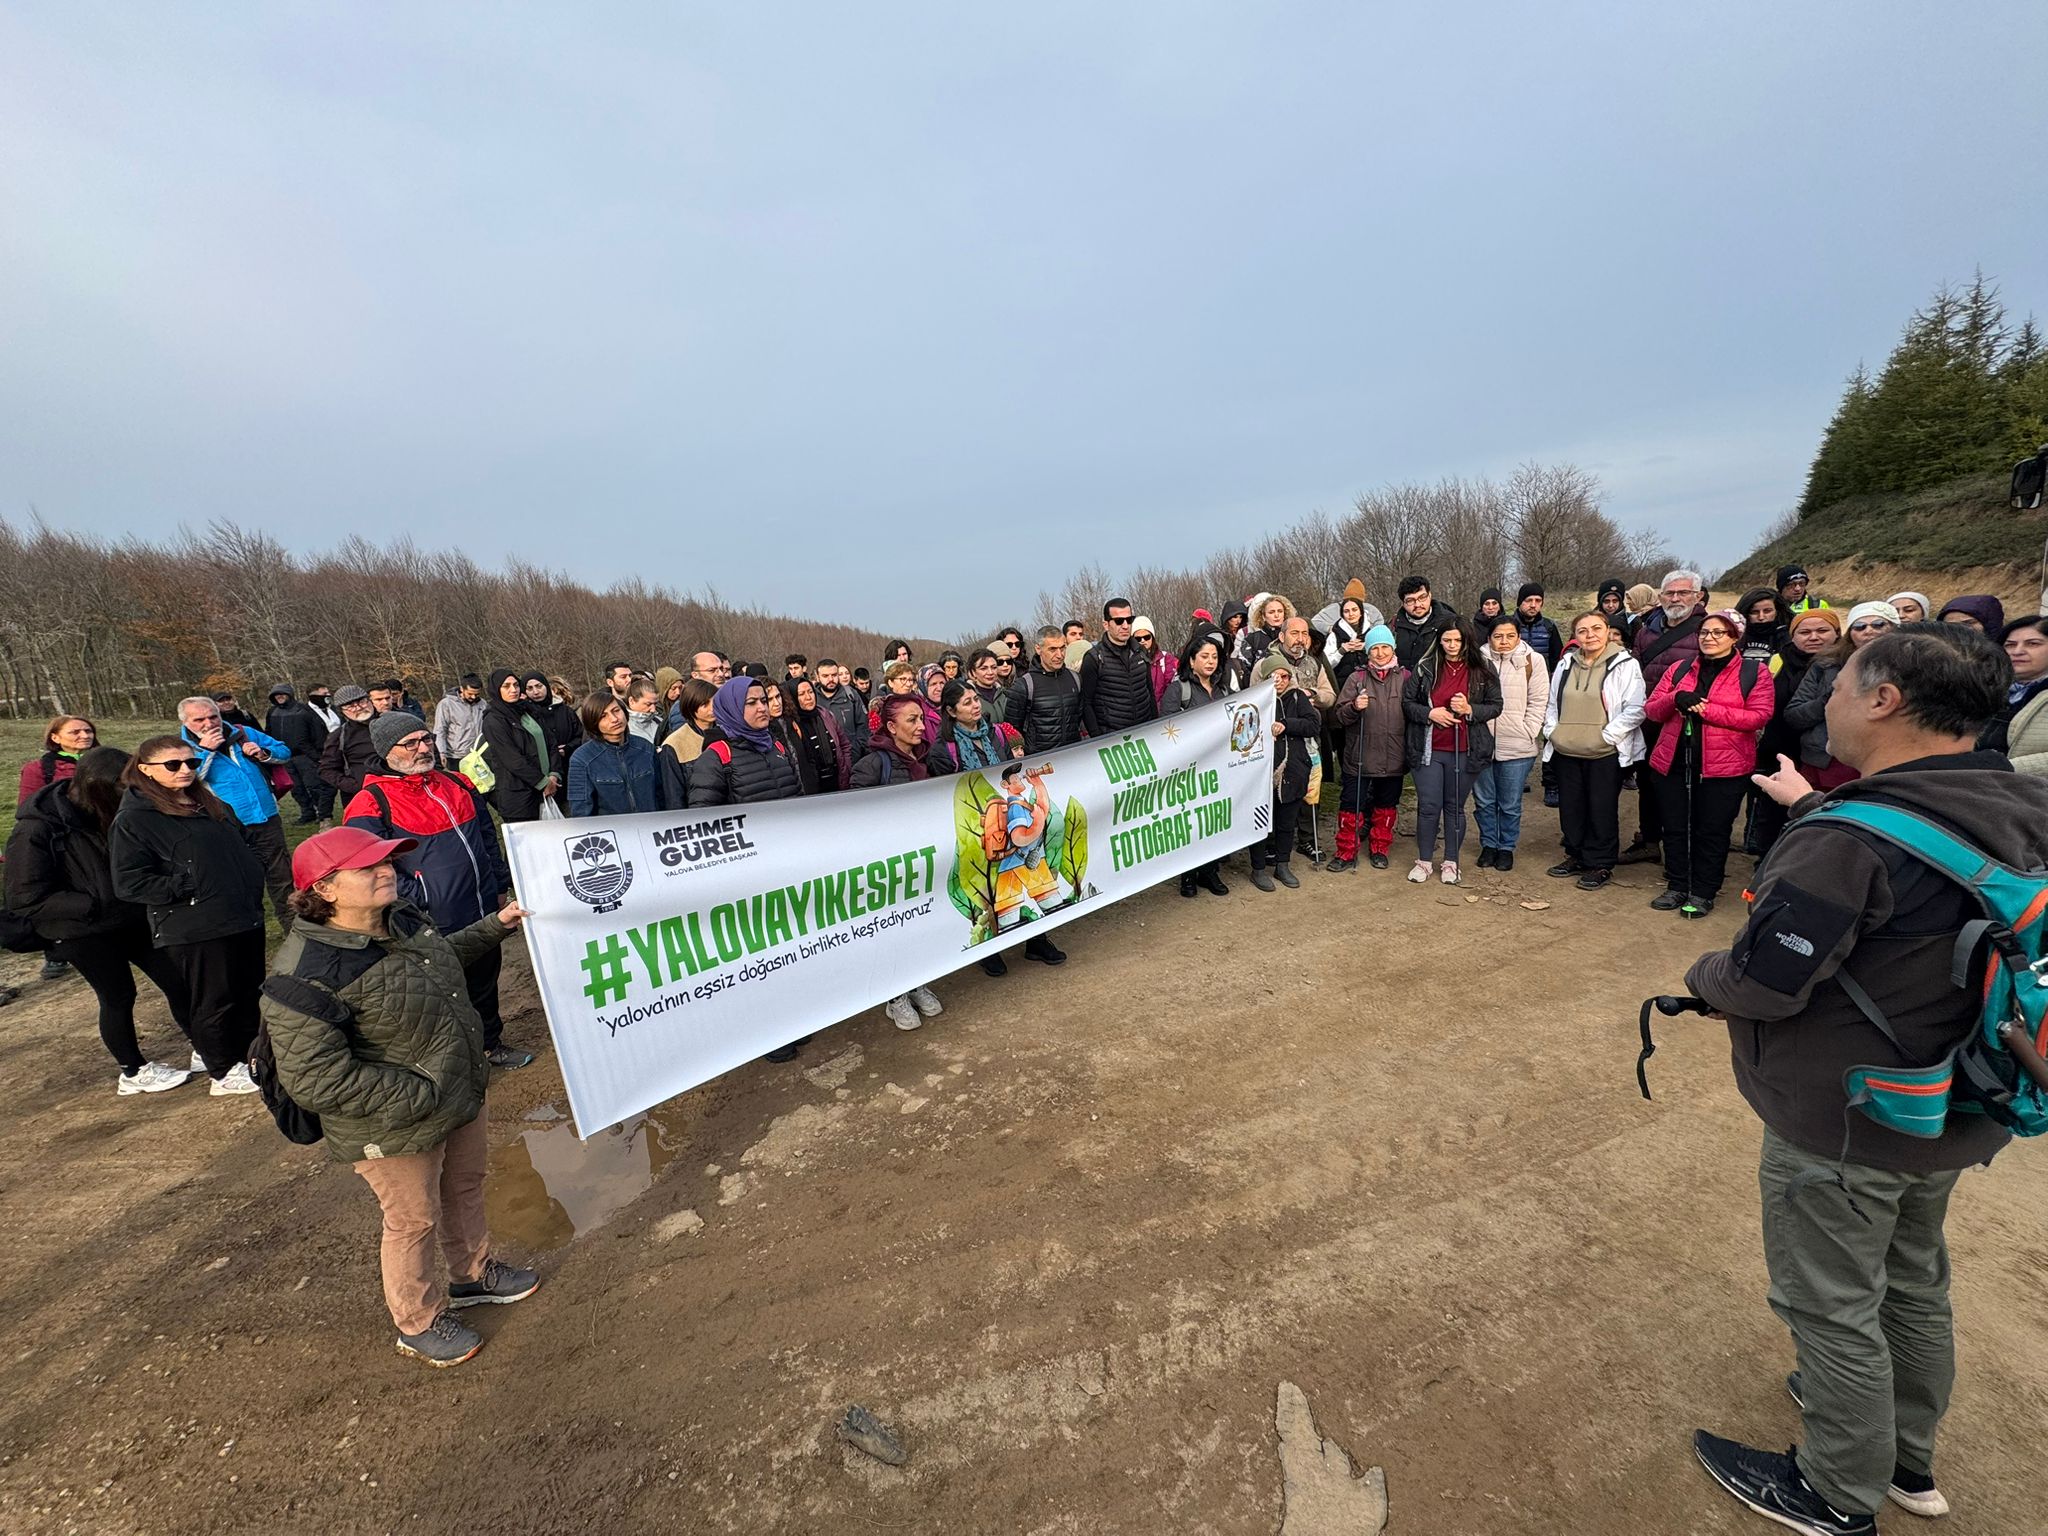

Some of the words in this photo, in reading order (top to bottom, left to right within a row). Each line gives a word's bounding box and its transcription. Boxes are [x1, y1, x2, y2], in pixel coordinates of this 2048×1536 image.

[1098, 735, 1157, 785] DOĞA
[1113, 761, 1197, 826] YÜRÜYÜŞÜ
[1199, 769, 1219, 798] ve
[652, 814, 746, 847] MEHMET
[659, 832, 754, 867] GÜREL
[1110, 810, 1192, 872] FOTOĞRAF
[1194, 797, 1232, 840] TURU
[566, 880, 591, 903] YALOVA
[664, 866, 694, 877] YALOVA
[581, 845, 936, 1009] #YALOVAYIKESFET
[694, 974, 736, 999] eşsiz
[739, 953, 797, 981] doğasını
[799, 929, 850, 959] birlikte
